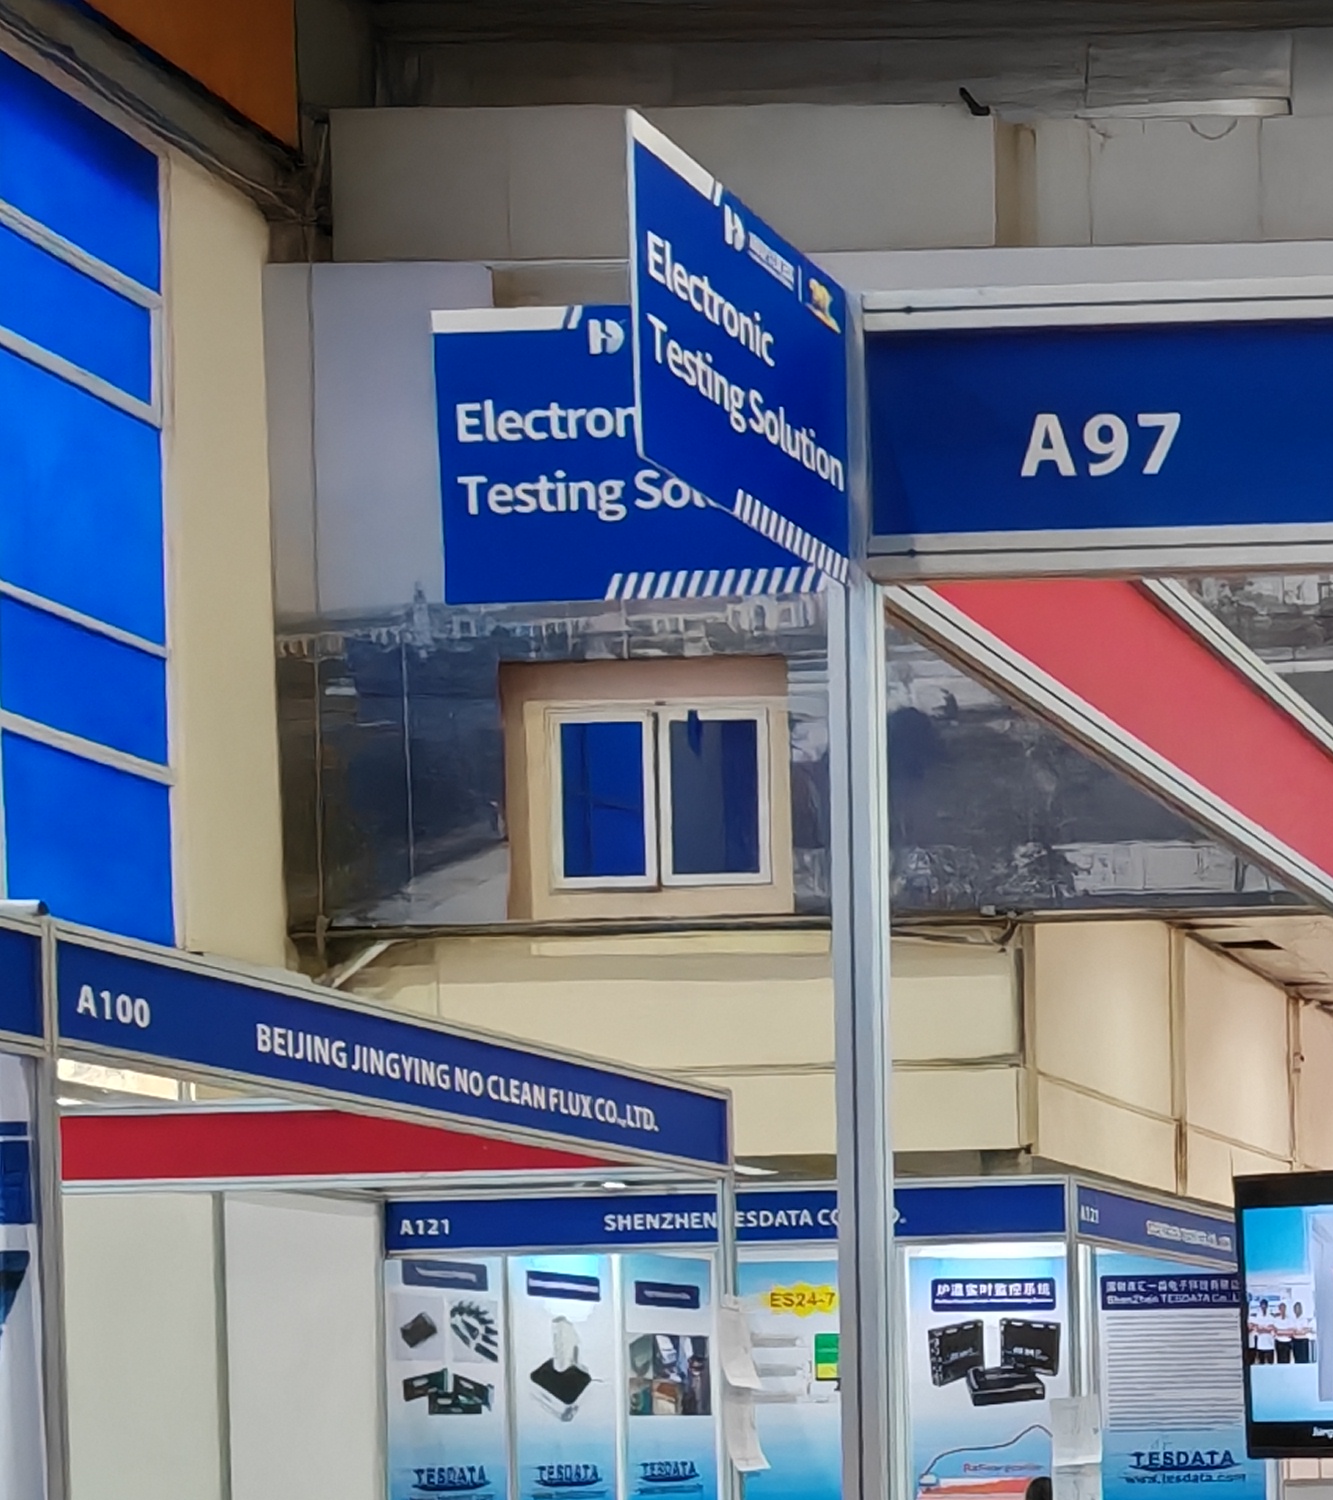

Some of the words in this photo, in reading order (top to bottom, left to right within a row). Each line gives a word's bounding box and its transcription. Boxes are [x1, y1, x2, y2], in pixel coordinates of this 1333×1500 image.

[646, 230, 775, 367] Electronic
[456, 399, 637, 443] Electron
[646, 313, 746, 433] Testing
[749, 388, 845, 492] Solution
[1020, 412, 1182, 478] A97
[457, 470, 628, 522] Testing
[75, 984, 151, 1028] A100
[255, 1022, 347, 1069] BEIJING
[351, 1043, 451, 1090] JINGYING
[454, 1066, 484, 1097] NO
[487, 1074, 546, 1110] CLEAN
[548, 1087, 593, 1119] FLUX
[399, 1218, 451, 1236] A121
[603, 1213, 718, 1232] SHENZHEN
[734, 1208, 814, 1228] ESDATA
[1128, 1449, 1237, 1468] TESDATA
